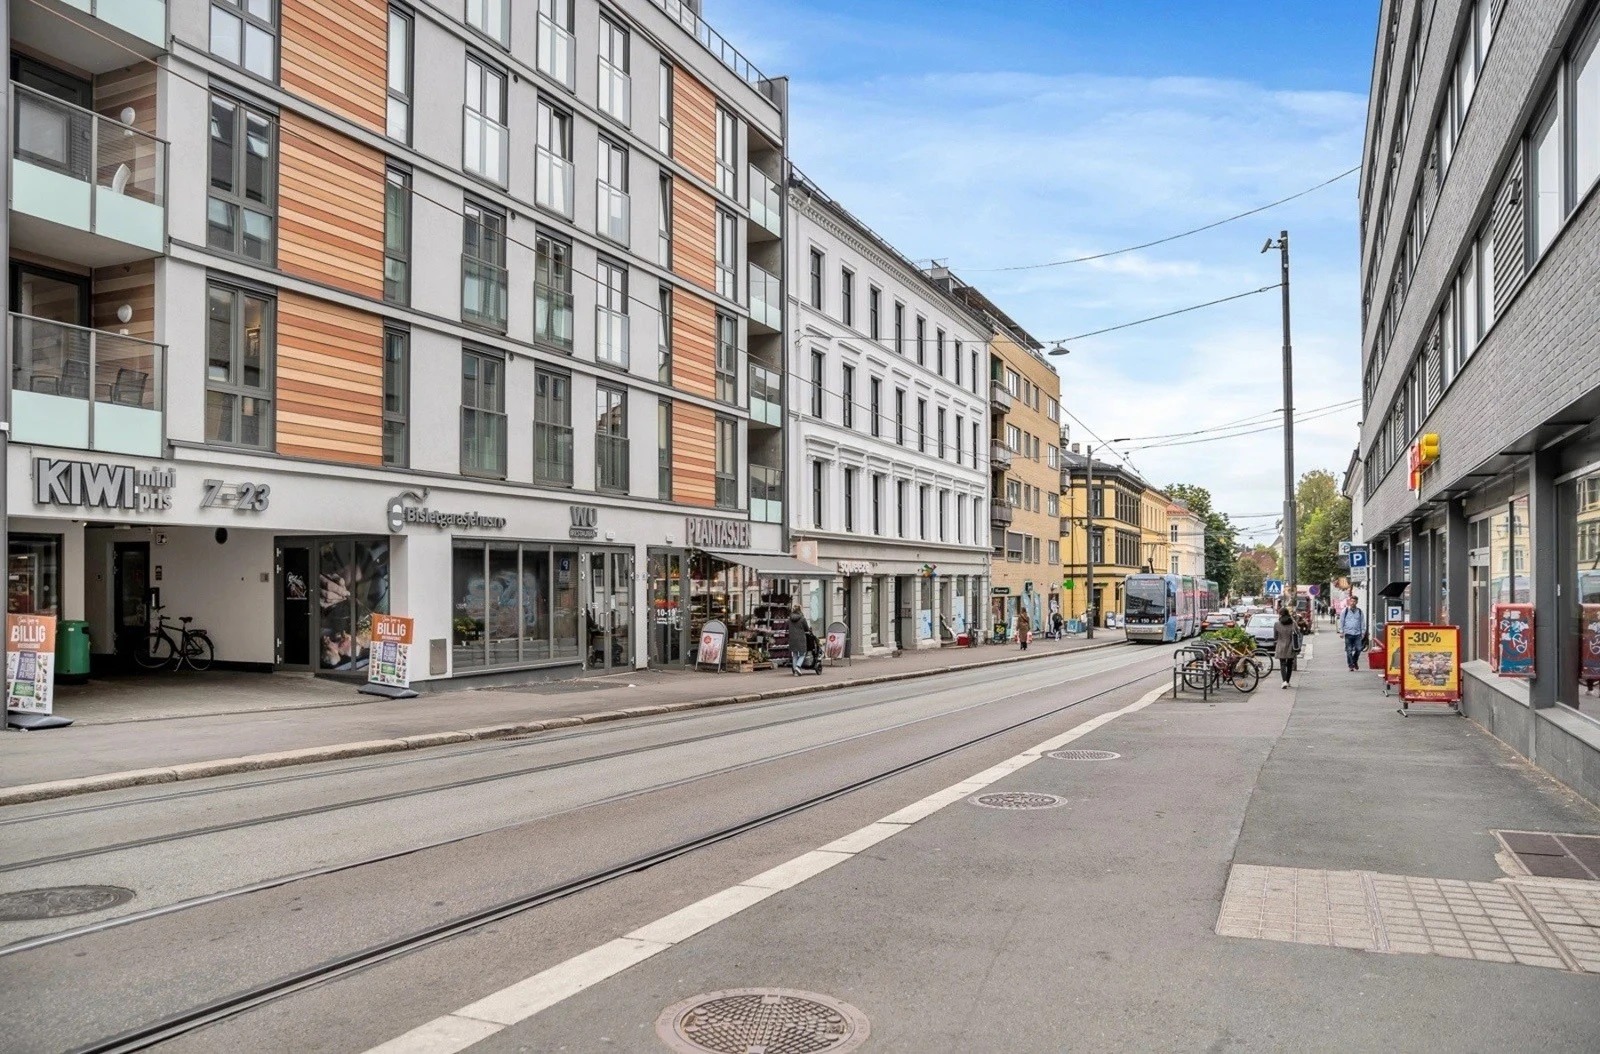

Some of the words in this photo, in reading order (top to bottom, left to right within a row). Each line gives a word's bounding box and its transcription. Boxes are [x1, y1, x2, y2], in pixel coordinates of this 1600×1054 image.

[36, 457, 136, 510] KIWI
[137, 466, 176, 488] mini
[137, 489, 172, 513] pris
[201, 479, 270, 512] 7-23
[404, 506, 506, 530] Bisletgarasjehus.no
[570, 506, 598, 527] WU
[686, 518, 751, 549] PLANTASJEN
[1353, 553, 1362, 566] P
[1391, 608, 1400, 619] P
[10, 625, 46, 643] BILLIG
[376, 622, 407, 637] BILLIG
[1407, 631, 1442, 643] -30%
